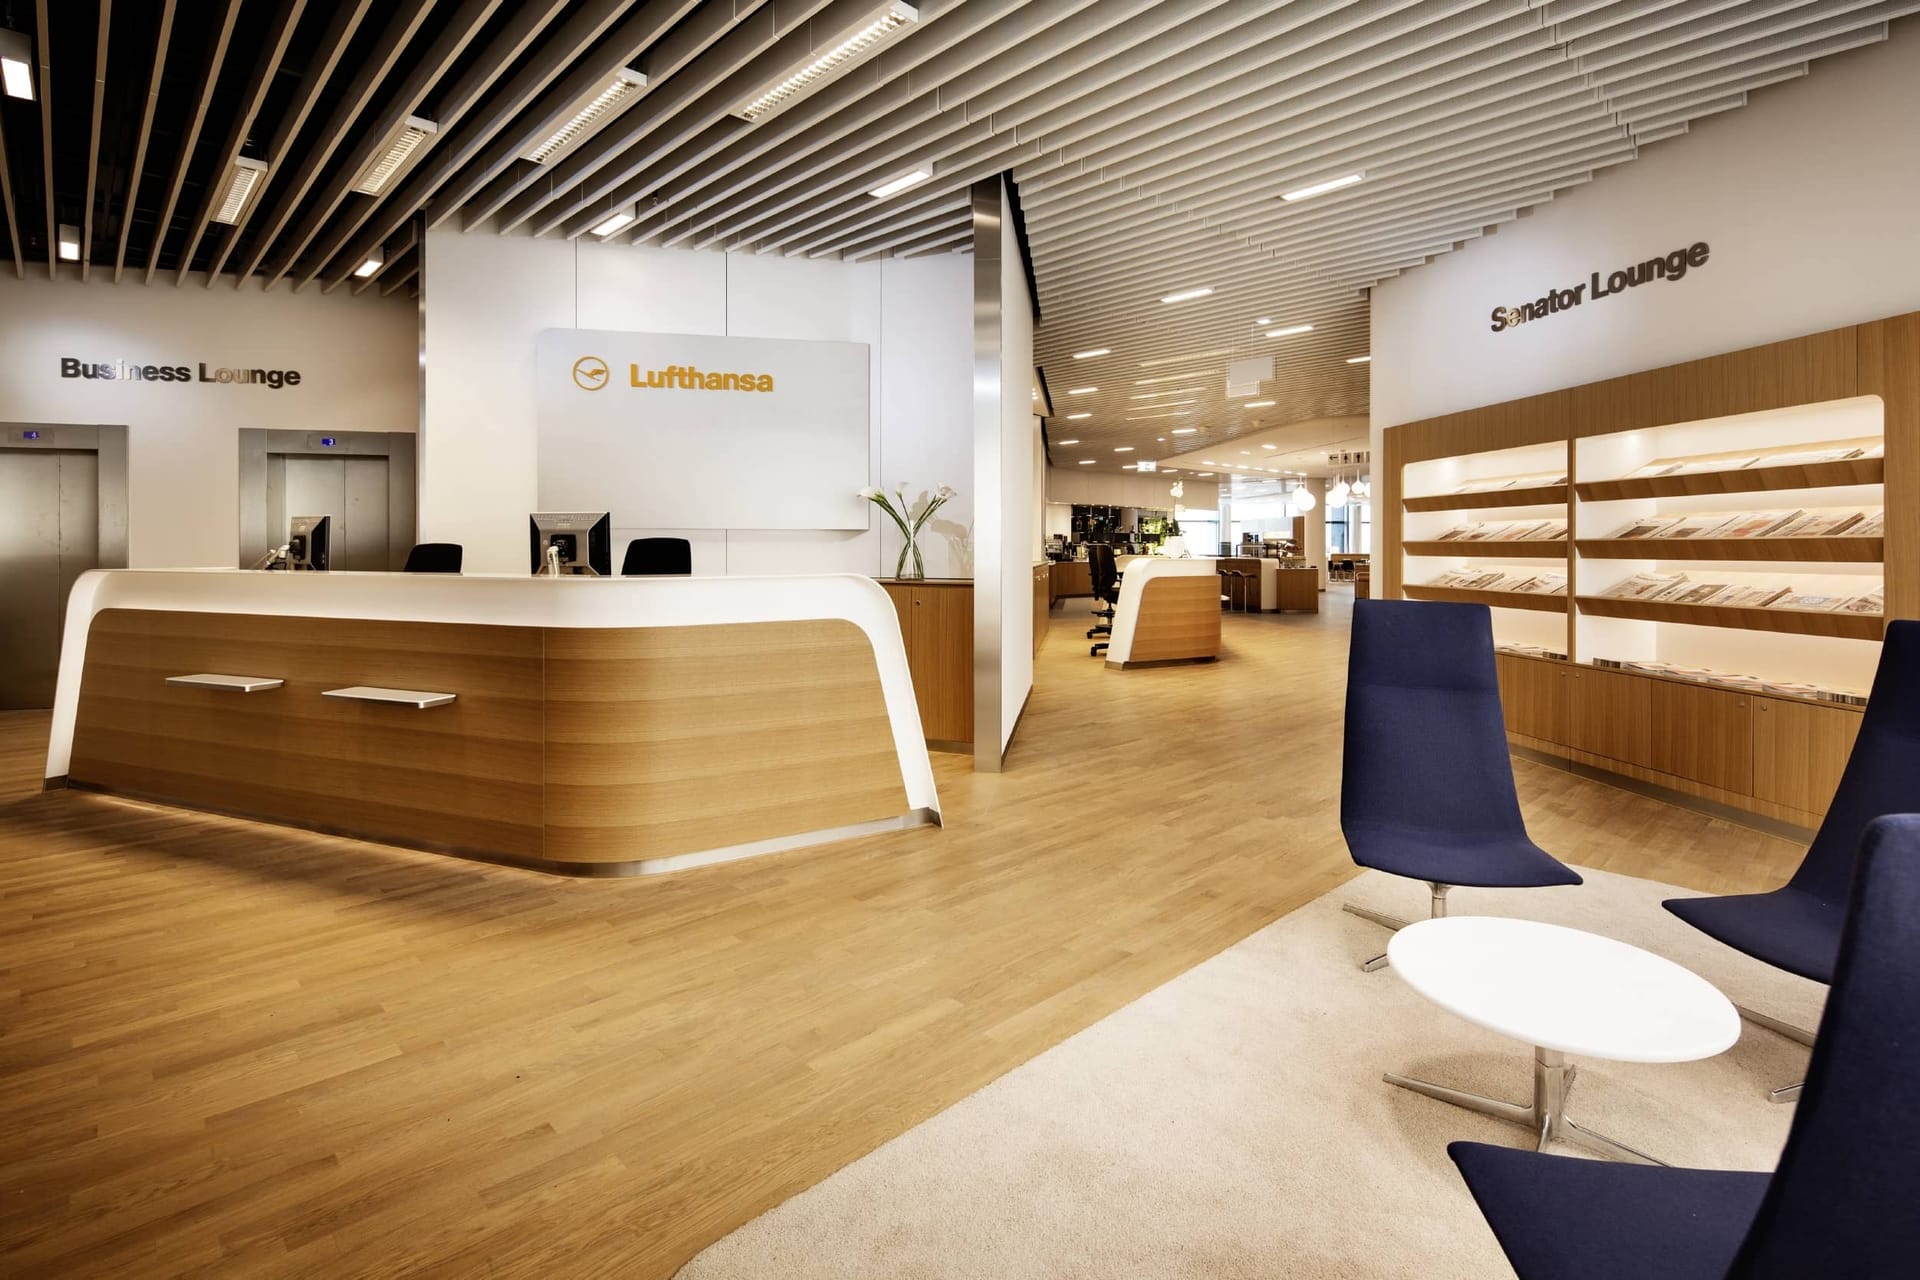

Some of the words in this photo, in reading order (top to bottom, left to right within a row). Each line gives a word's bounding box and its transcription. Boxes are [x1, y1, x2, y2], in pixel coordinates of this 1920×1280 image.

[1490, 282, 1586, 332] Senator
[1591, 241, 1710, 300] Lounge
[60, 357, 192, 382] Business
[199, 362, 301, 389] Lounge
[630, 363, 774, 392] Lufthansa
